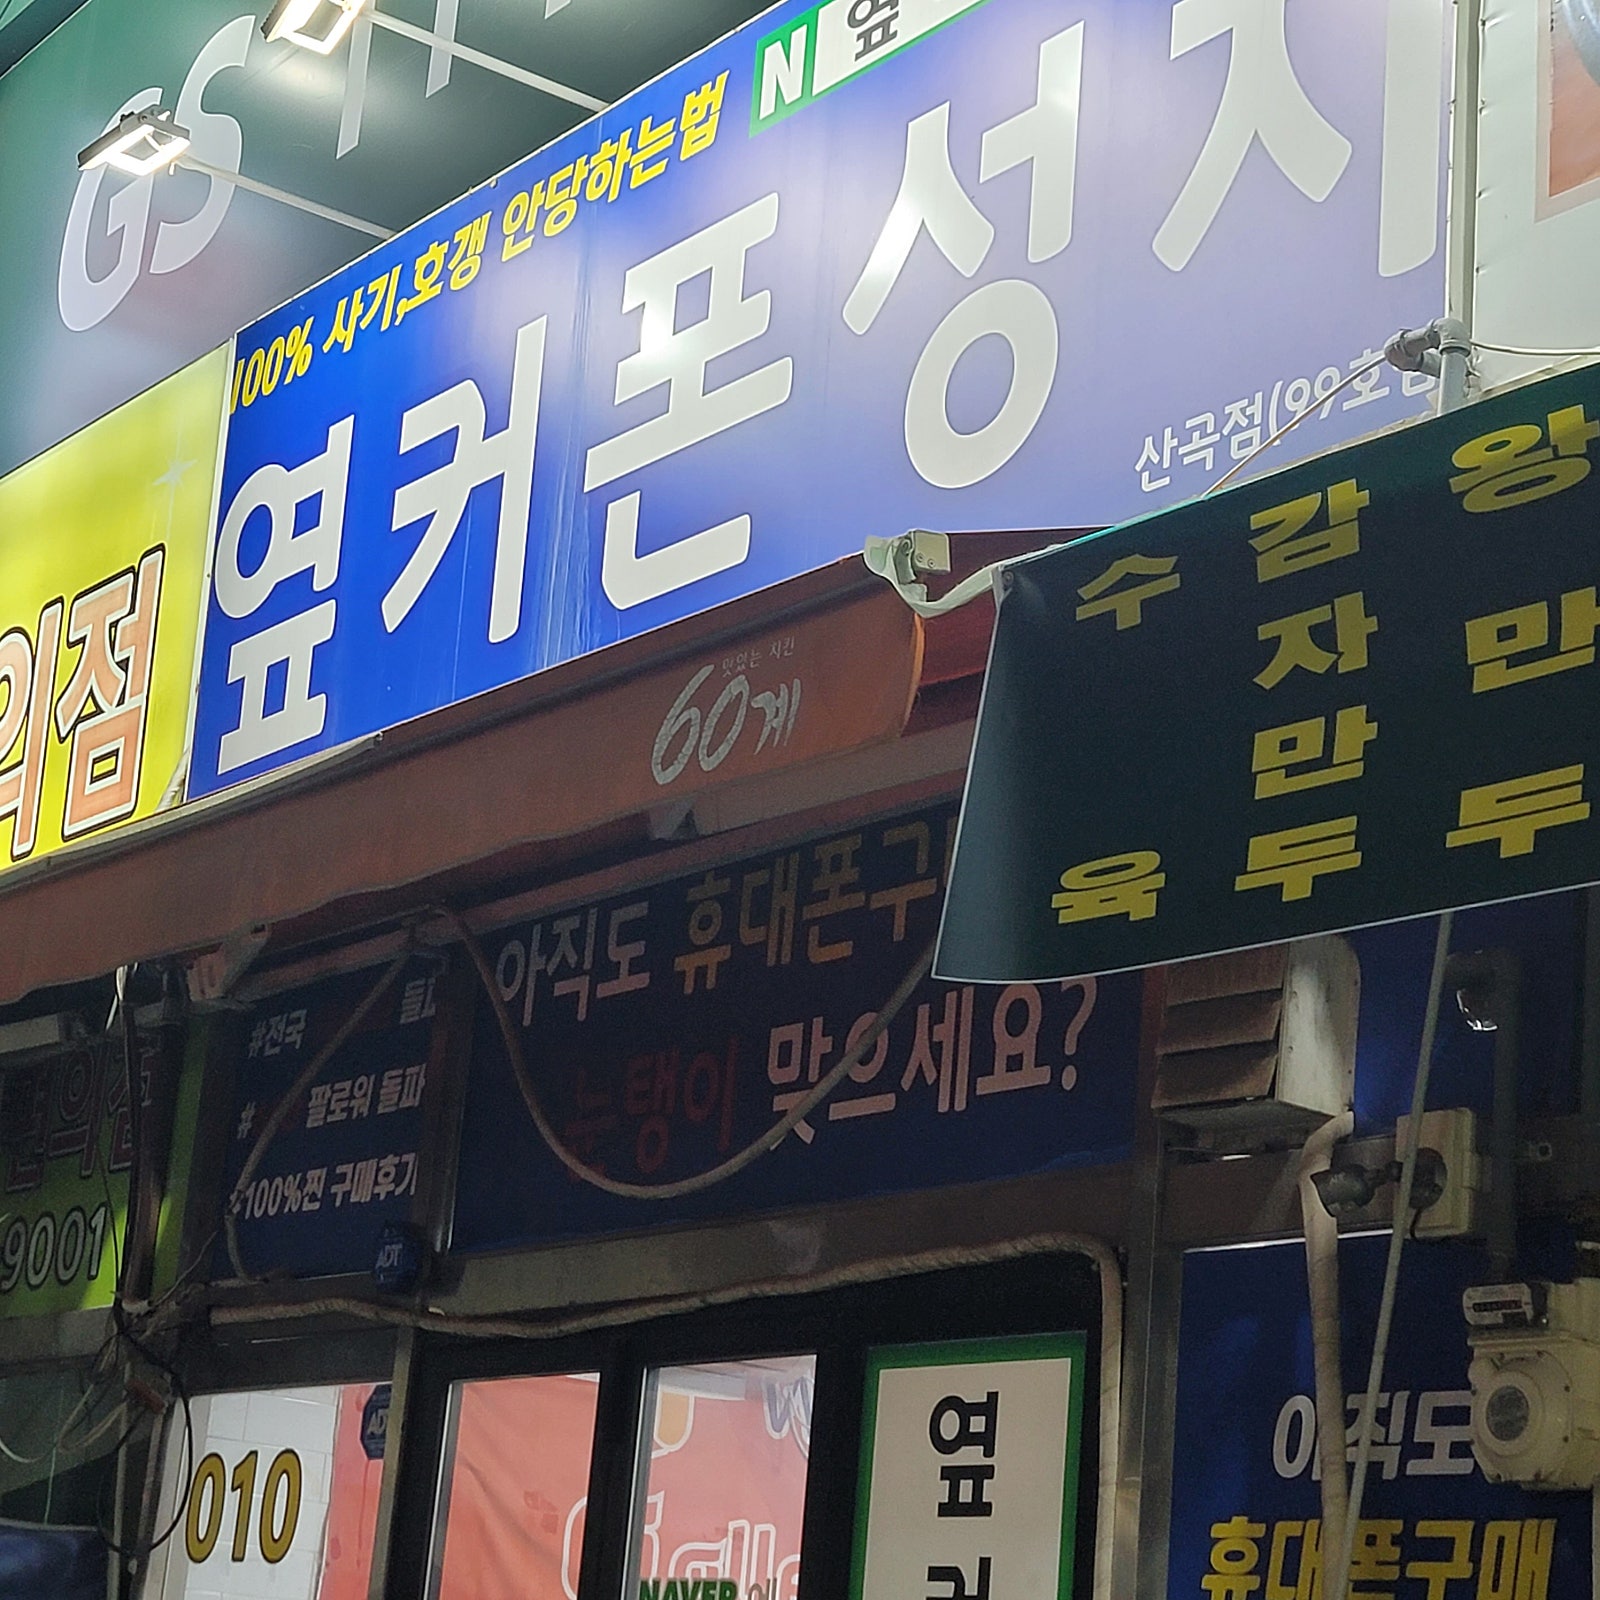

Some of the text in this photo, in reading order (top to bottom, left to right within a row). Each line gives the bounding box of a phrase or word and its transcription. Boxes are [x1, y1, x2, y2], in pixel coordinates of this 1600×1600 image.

[759, 24, 808, 120] N
[58, 15, 256, 332] GS
[229, 316, 313, 416] 100%
[501, 69, 731, 263] 안당하는법
[1135, 348, 1438, 493] 산곡점(99호
[768, 634, 796, 660] 치킨
[651, 663, 802, 786] 60계
[495, 903, 651, 1027] 아직도
[305, 1074, 376, 1129] 팔로워
[377, 1063, 427, 1116] 돌파
[767, 977, 1100, 1151] 맞으세요?
[330, 1152, 419, 1209] 구매후기
[186, 1449, 302, 1564] 010
